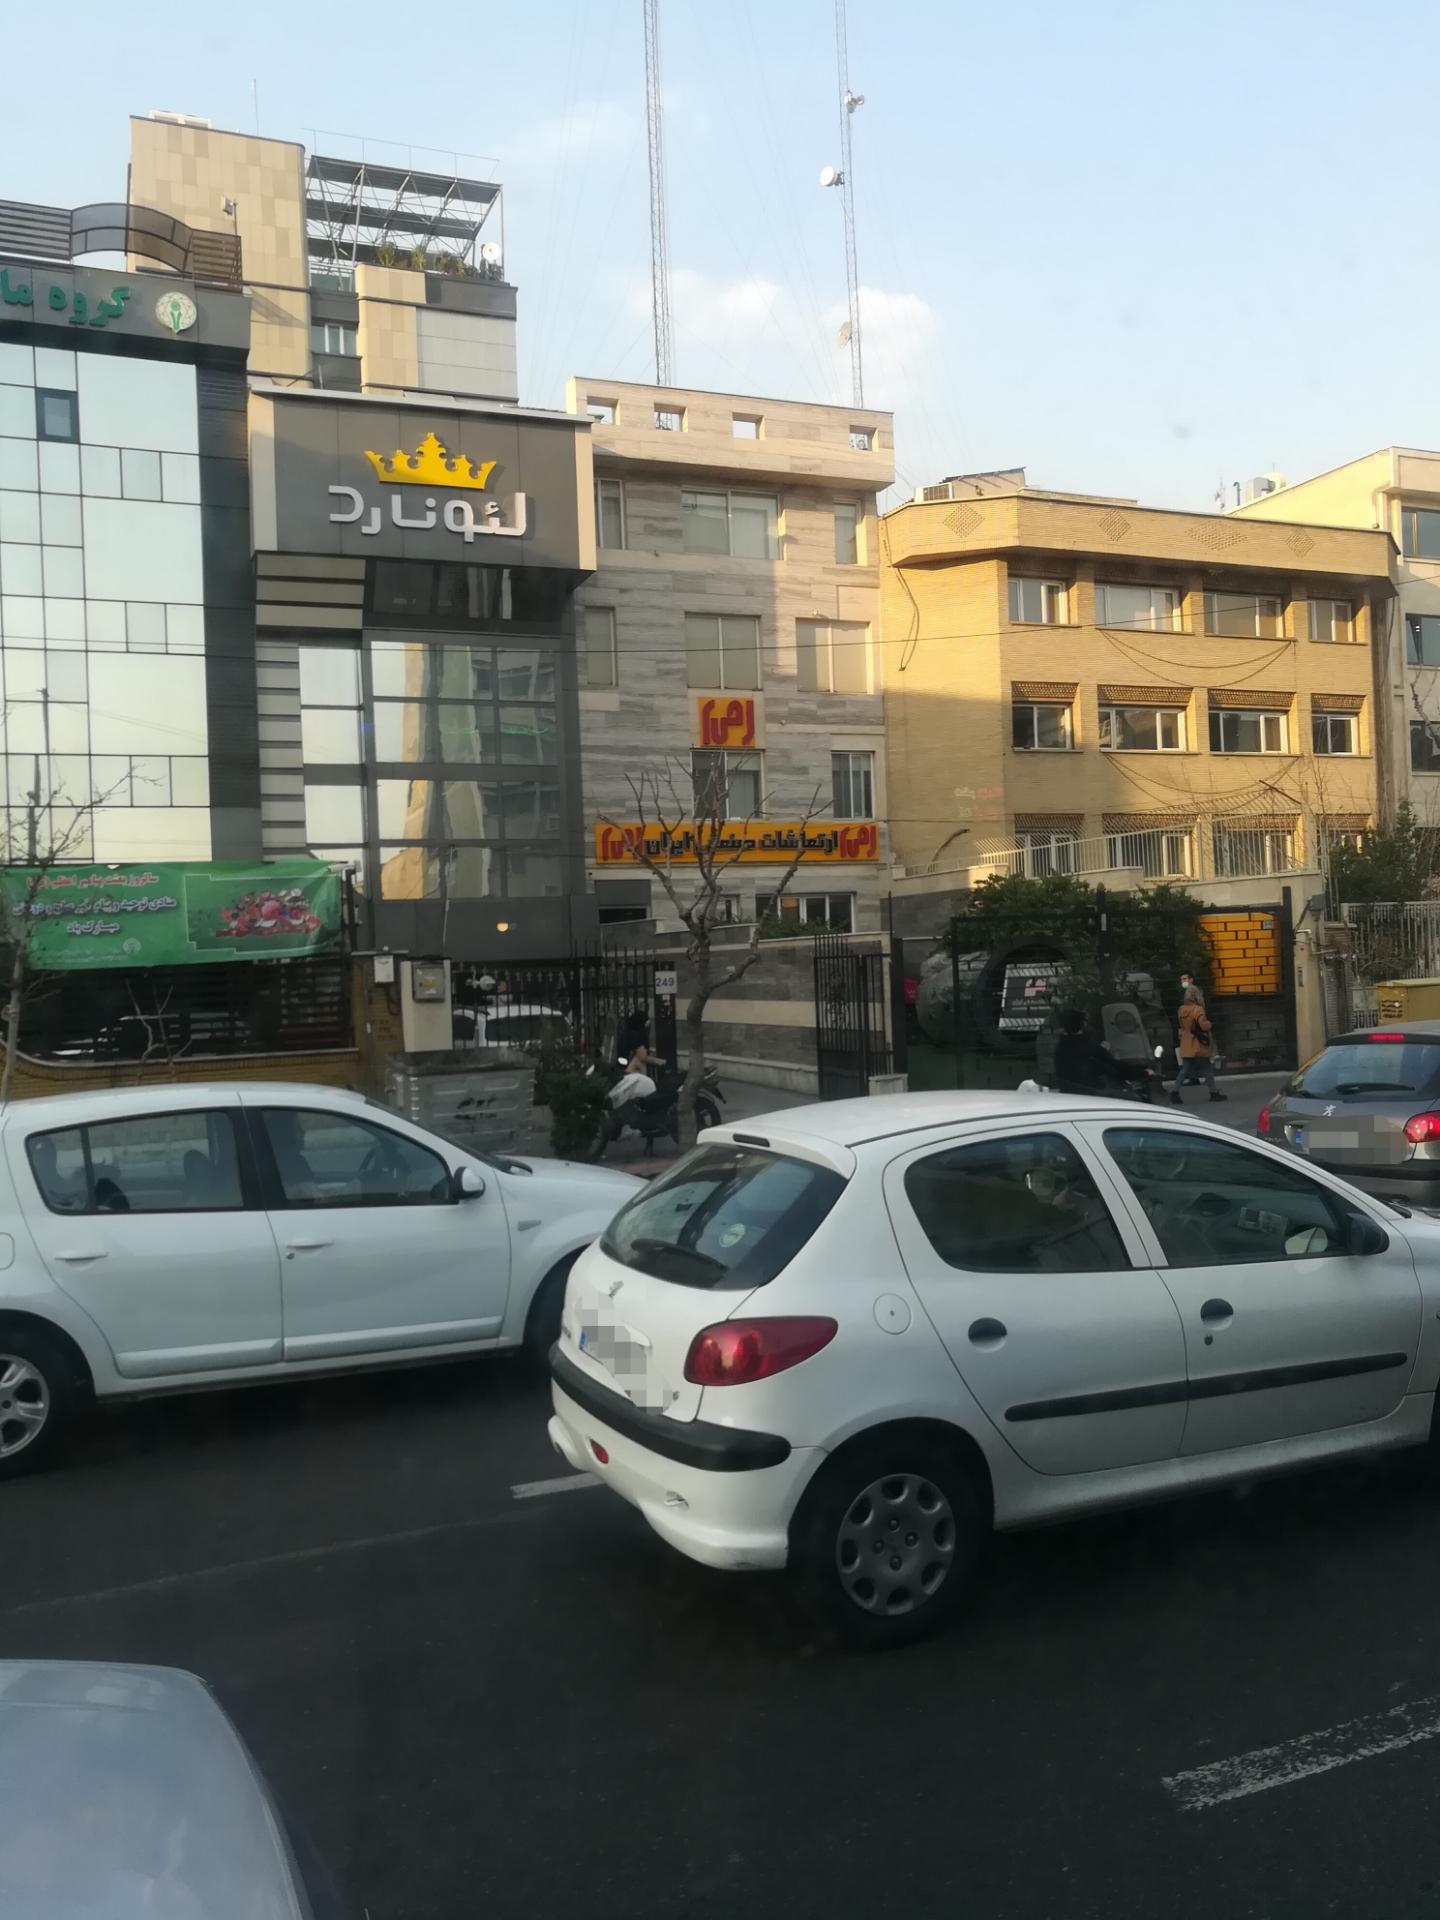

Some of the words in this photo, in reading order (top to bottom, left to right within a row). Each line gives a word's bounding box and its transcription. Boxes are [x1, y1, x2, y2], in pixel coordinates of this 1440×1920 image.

[49, 285, 130, 327] گروه
[328, 485, 527, 543] لئونارد
[761, 829, 839, 855] ارتعاشات
[655, 977, 673, 987] 249
